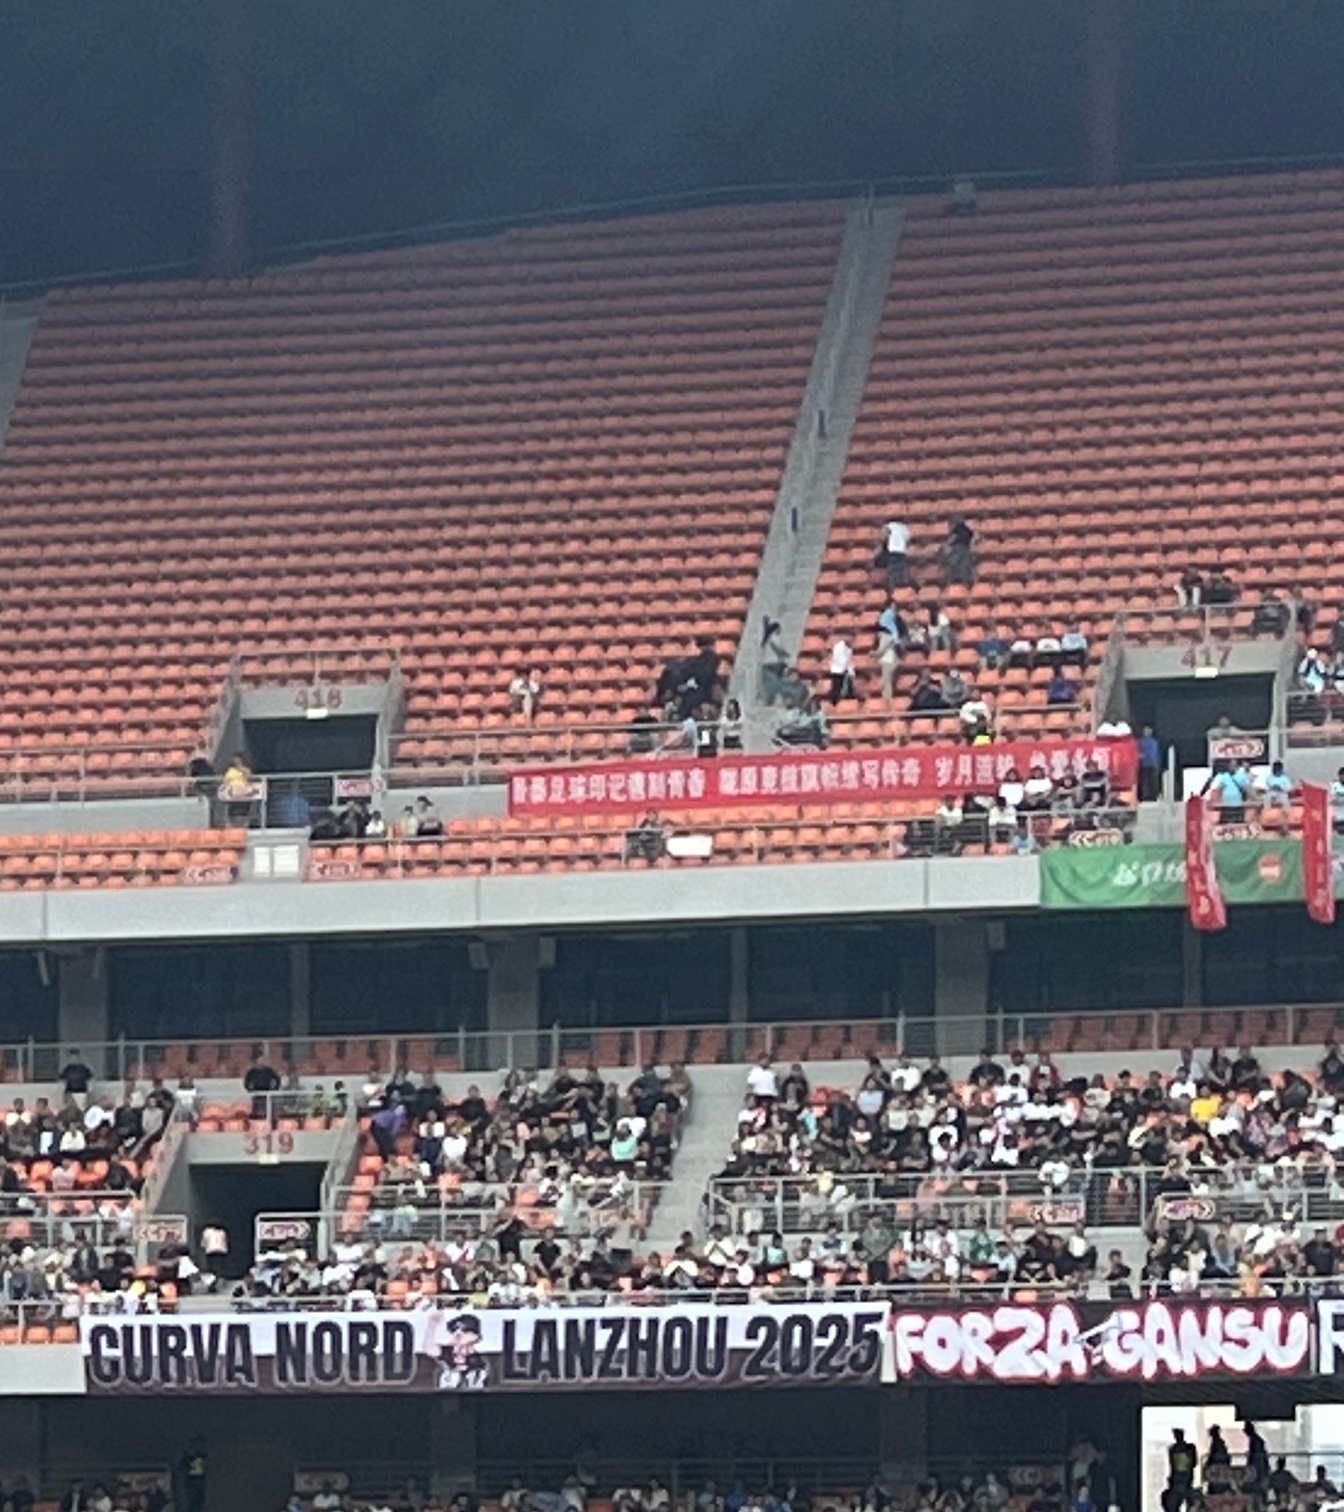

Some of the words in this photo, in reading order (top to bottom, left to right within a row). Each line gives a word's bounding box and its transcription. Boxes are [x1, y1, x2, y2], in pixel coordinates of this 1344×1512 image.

[245, 1132, 295, 1154] 319
[88, 1321, 258, 1388] CURVA
[273, 1317, 418, 1386] NORD
[501, 1314, 730, 1382] LANZHOU
[738, 1311, 887, 1376] 2025
[893, 1302, 1088, 1381] FORZA
[1106, 1301, 1309, 1379] GANSU
